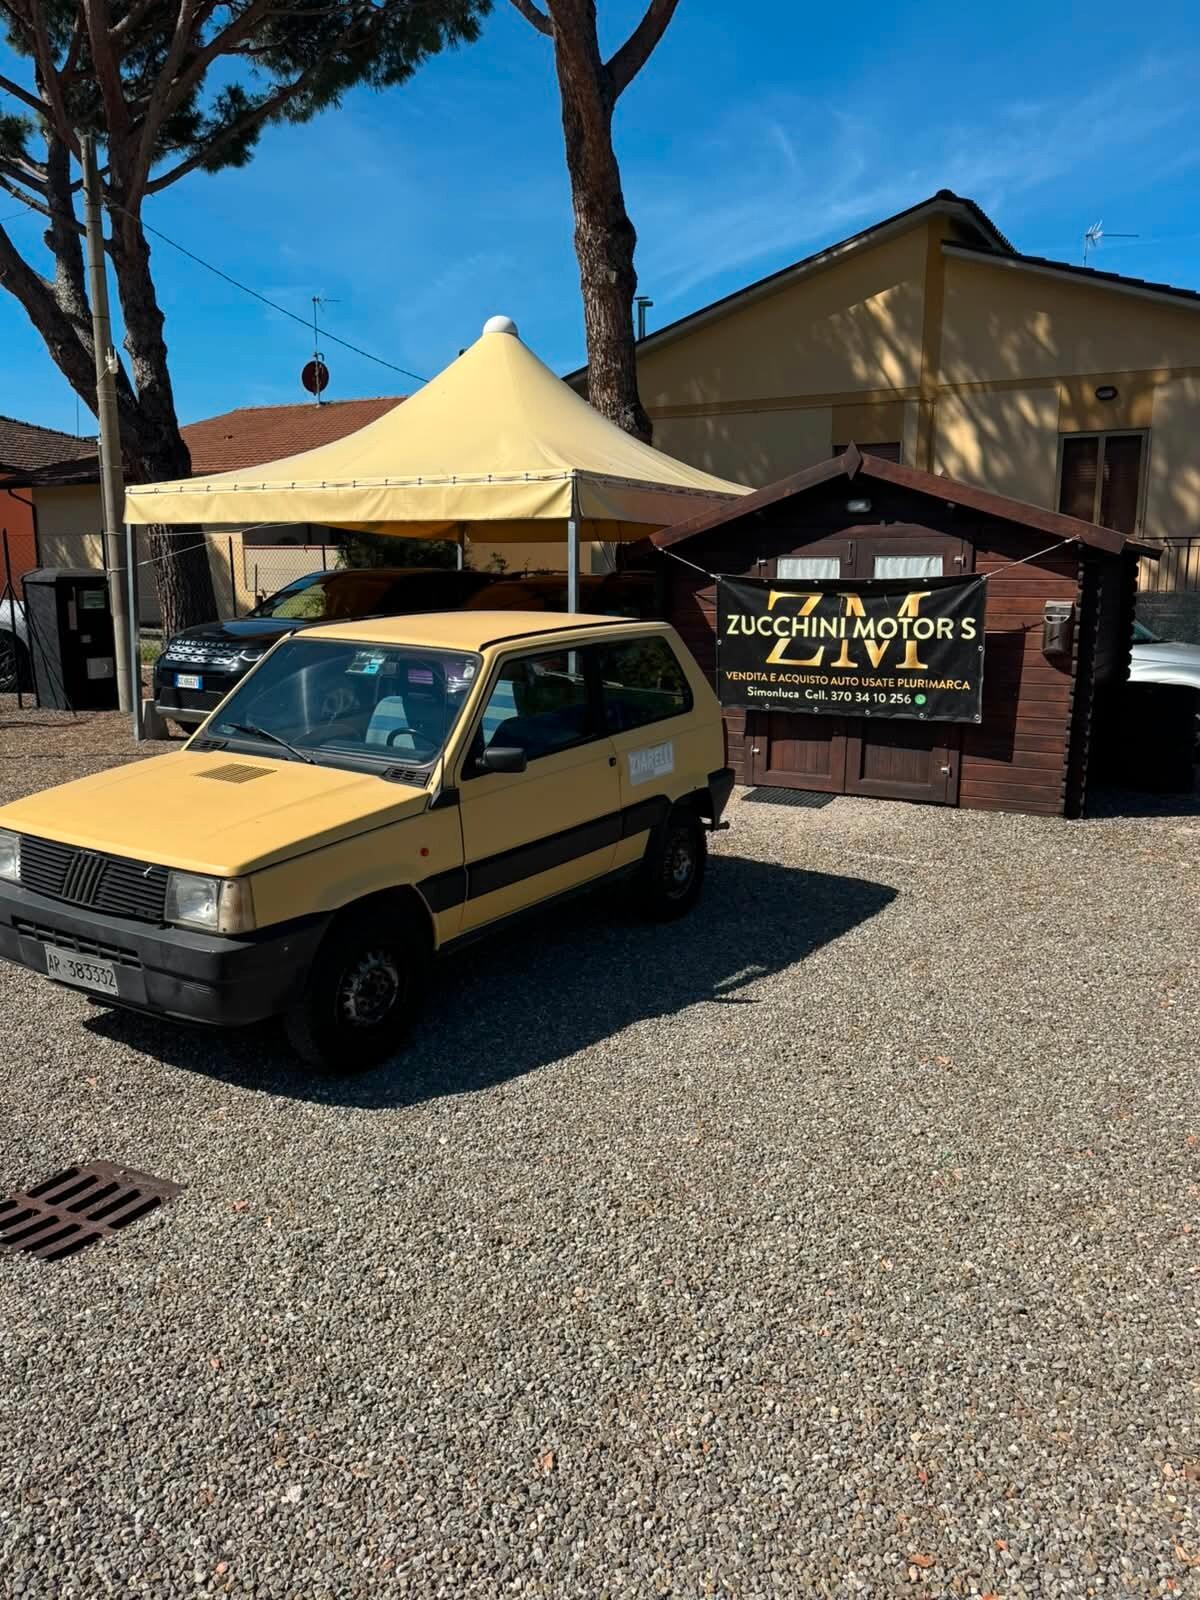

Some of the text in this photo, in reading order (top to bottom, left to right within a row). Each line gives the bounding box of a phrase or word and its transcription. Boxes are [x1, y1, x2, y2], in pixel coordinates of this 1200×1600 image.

[726, 615, 846, 638] ZUCCHINI
[726, 671, 971, 691] VENDITA E ACQUISTO AUTO USATE PLURIMARCA
[747, 686, 912, 705] Simonluca Cell. 370 34 10 256
[67, 960, 116, 988] 383332
